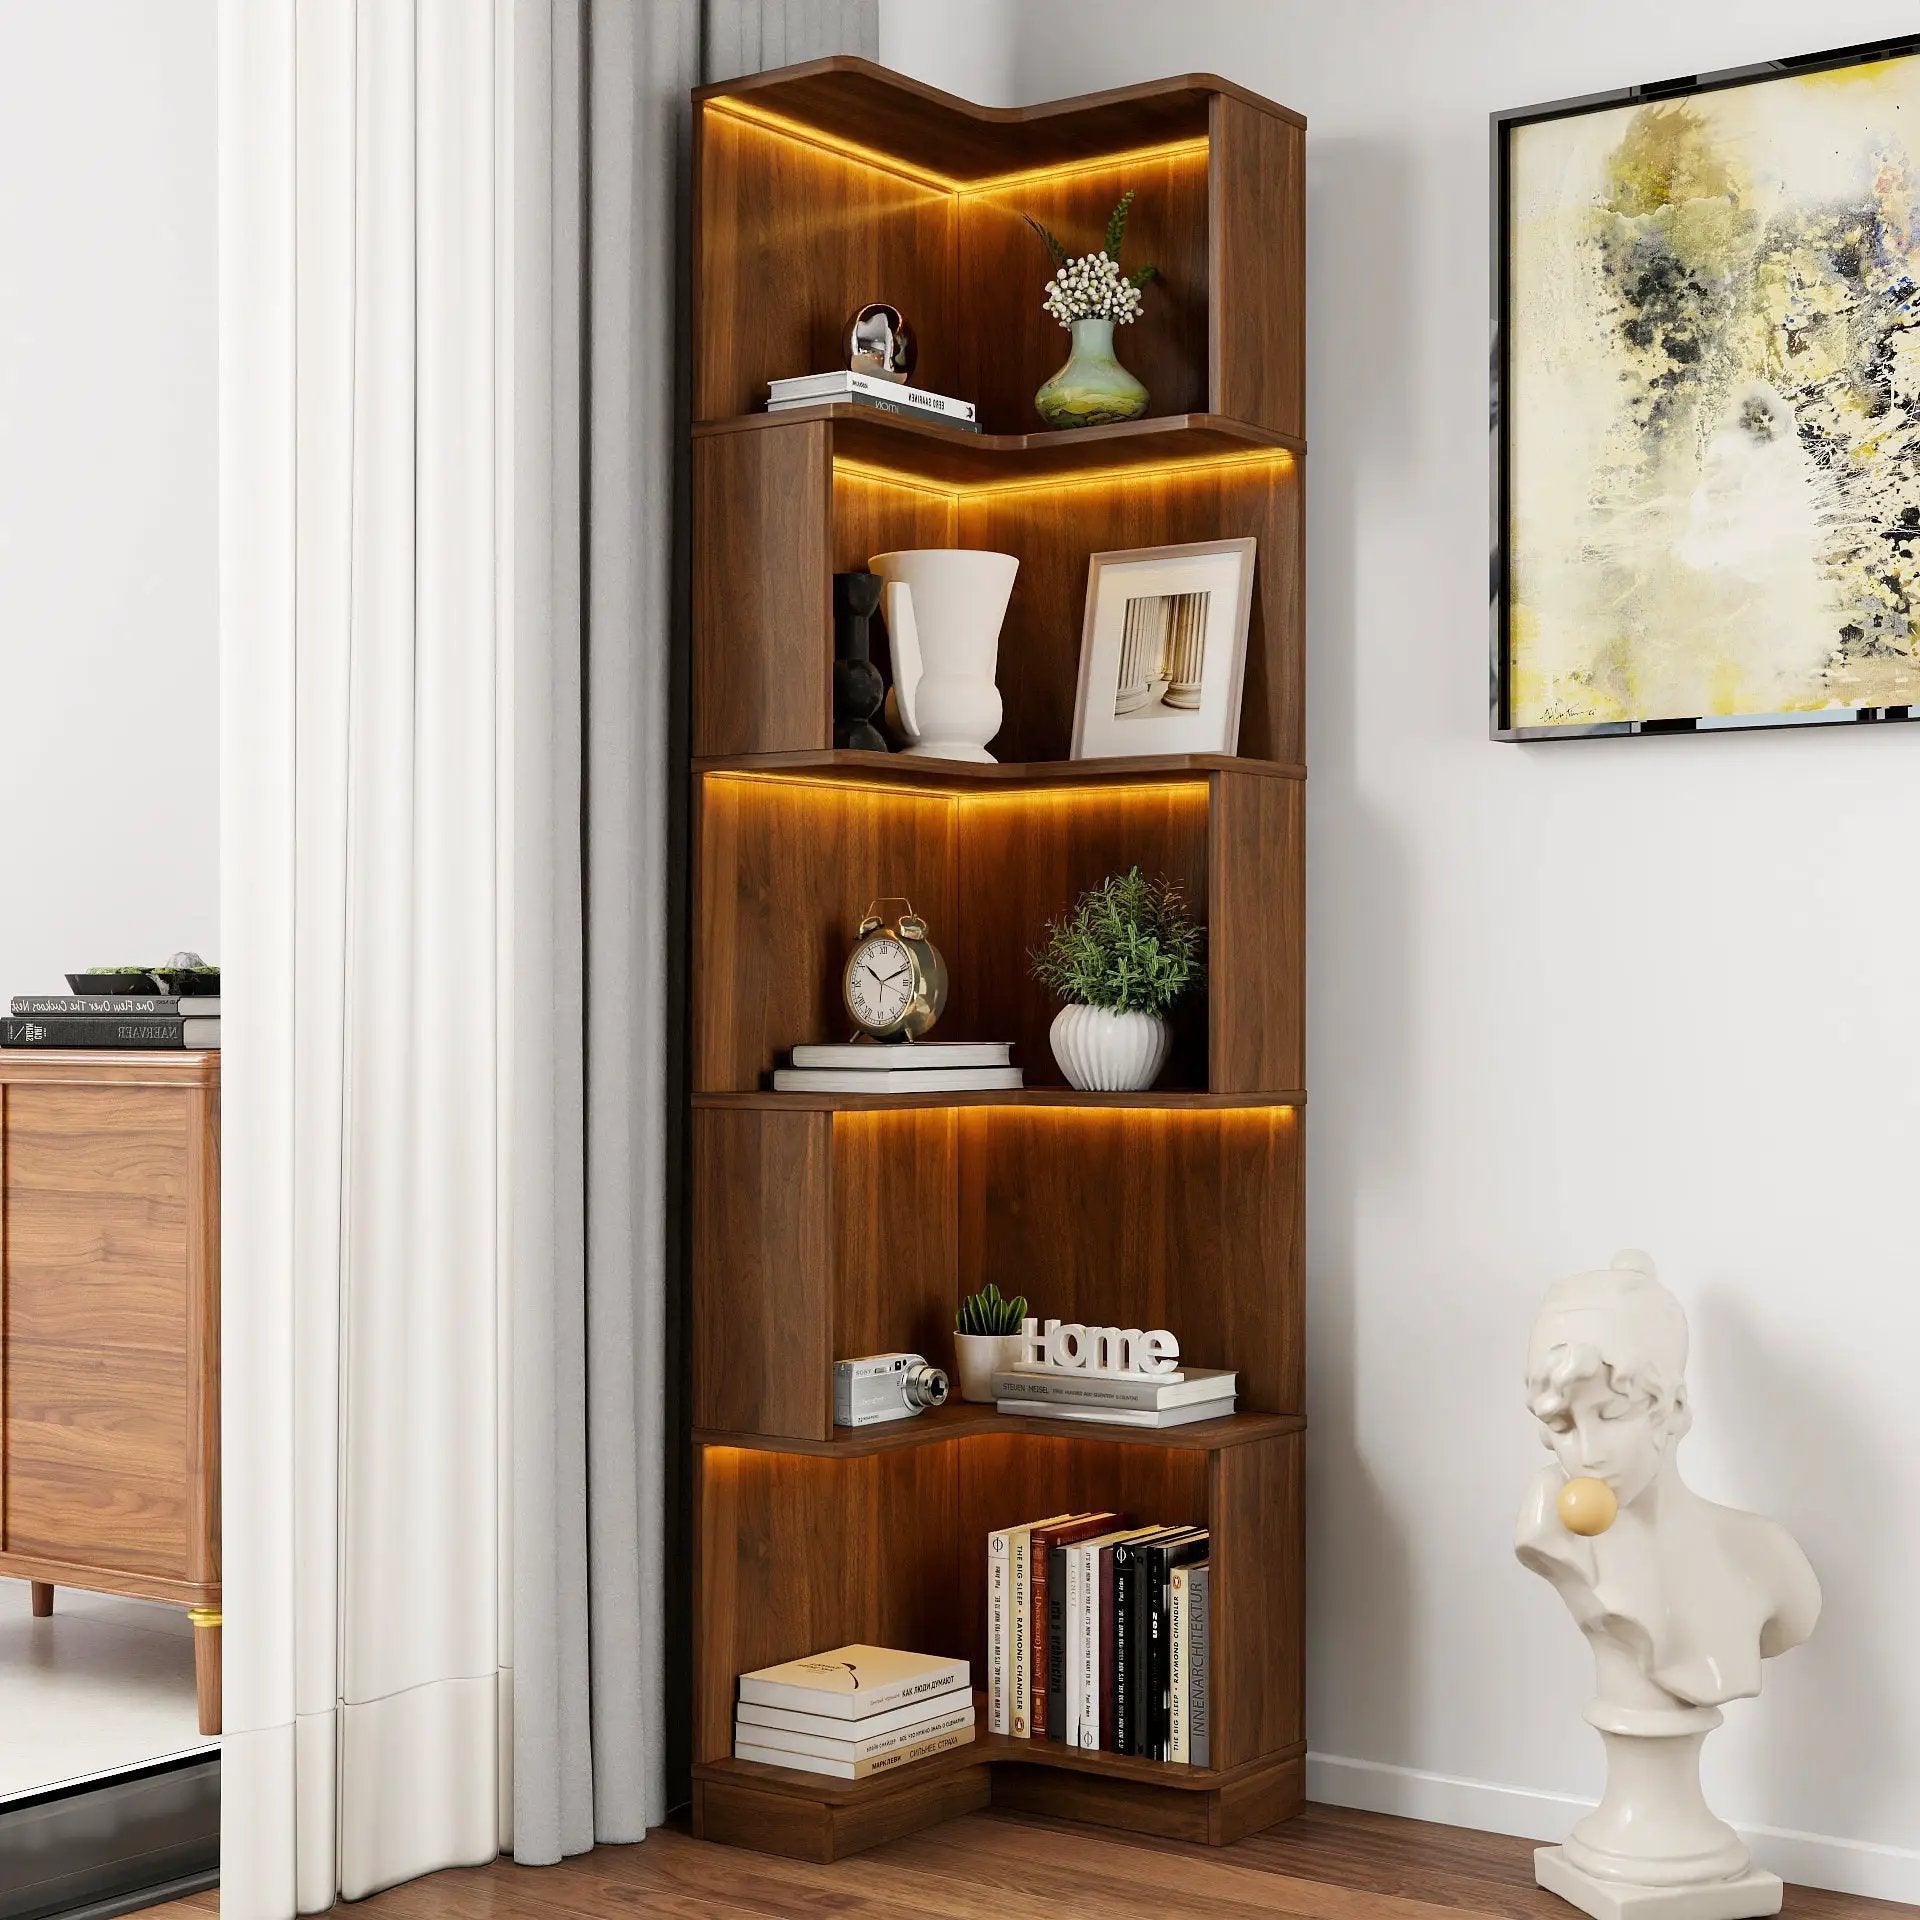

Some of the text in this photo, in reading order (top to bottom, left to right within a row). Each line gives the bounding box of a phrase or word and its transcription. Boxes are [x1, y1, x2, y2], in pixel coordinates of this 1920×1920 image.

[1019, 1317, 1180, 1373] Home
[1190, 1583, 1205, 1738] INNENARCHITEKTUR
[902, 1688, 913, 1698] КАК
[931, 1675, 955, 1690] ДУМАЮТ
[871, 1760, 887, 1770] МАРК
[909, 1743, 937, 1759] СИЛЬНЕЕ
[937, 1736, 958, 1749] СТРАХА
